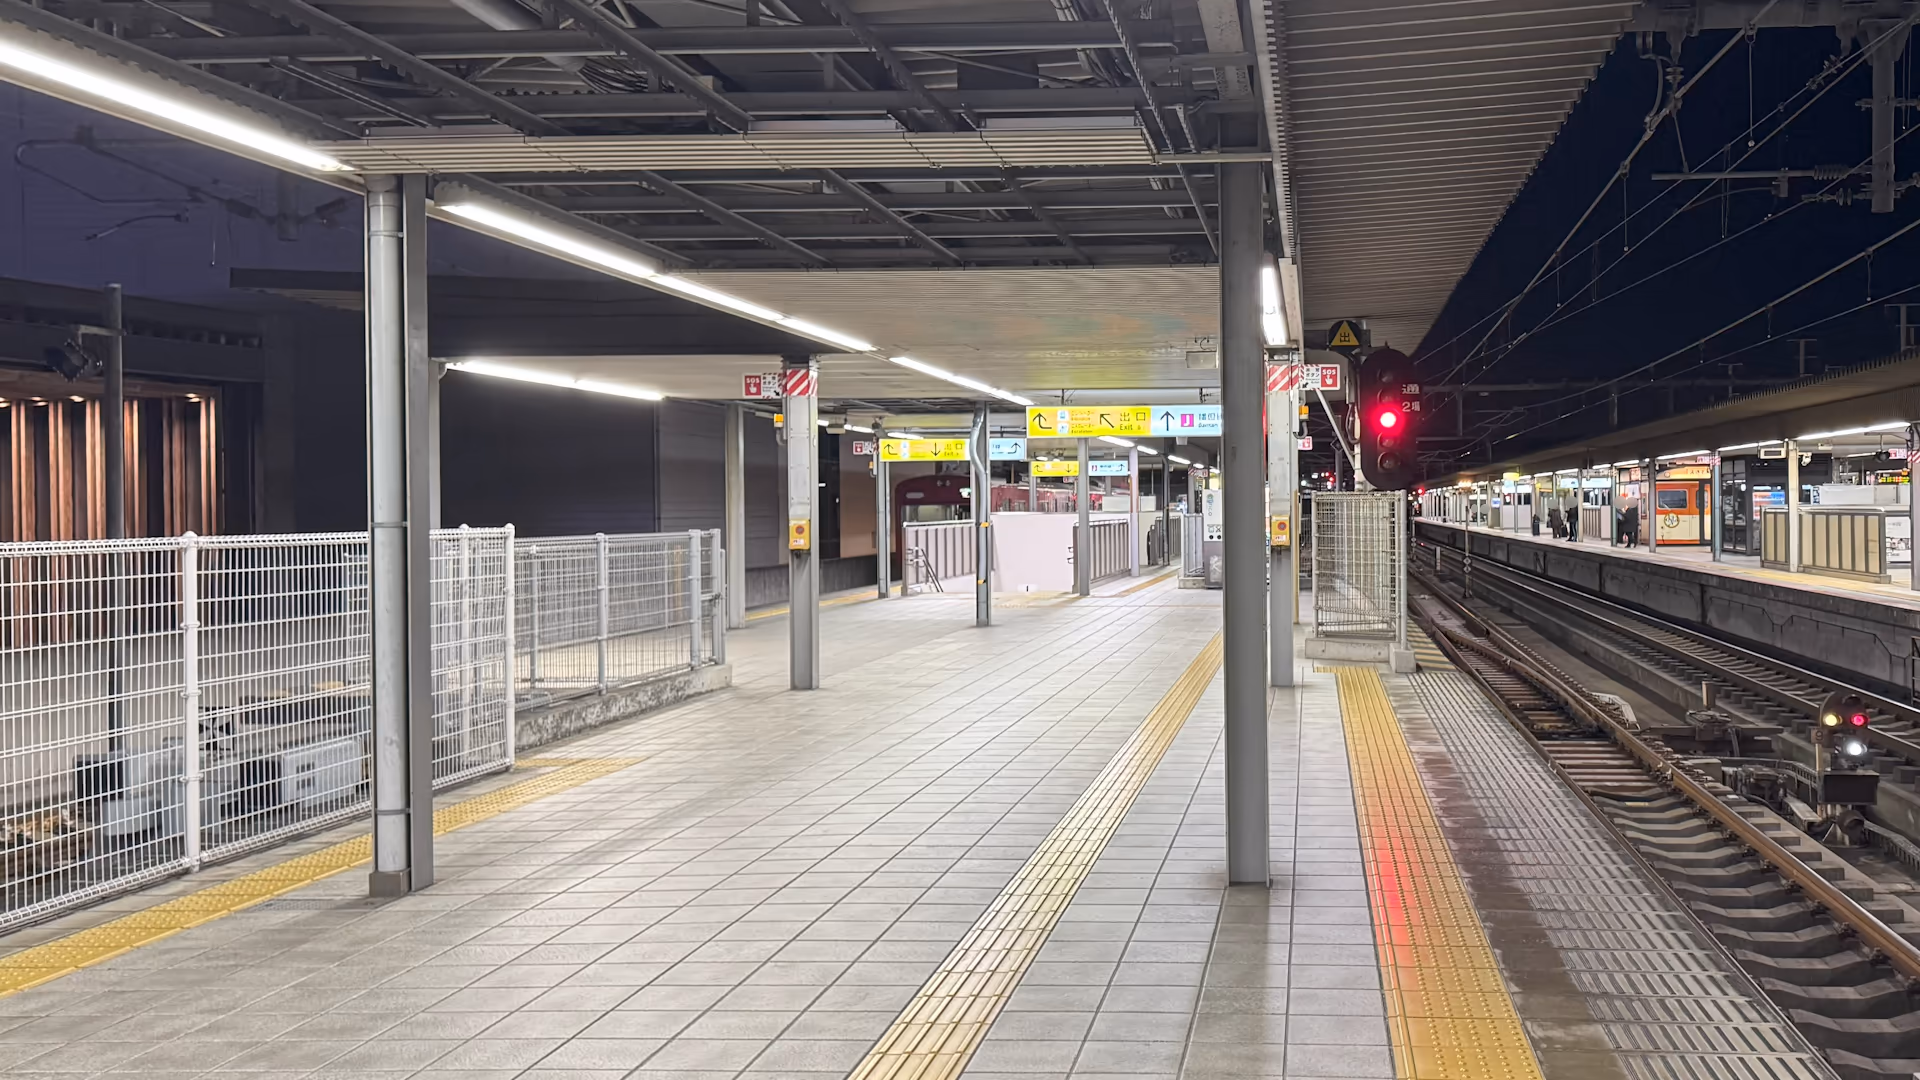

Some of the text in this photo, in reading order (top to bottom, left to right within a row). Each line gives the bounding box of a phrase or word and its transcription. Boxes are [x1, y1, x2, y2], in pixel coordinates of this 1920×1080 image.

[1340, 332, 1350, 343] 出
[1119, 411, 1146, 422] 出口
[1119, 423, 1133, 431] Exit
